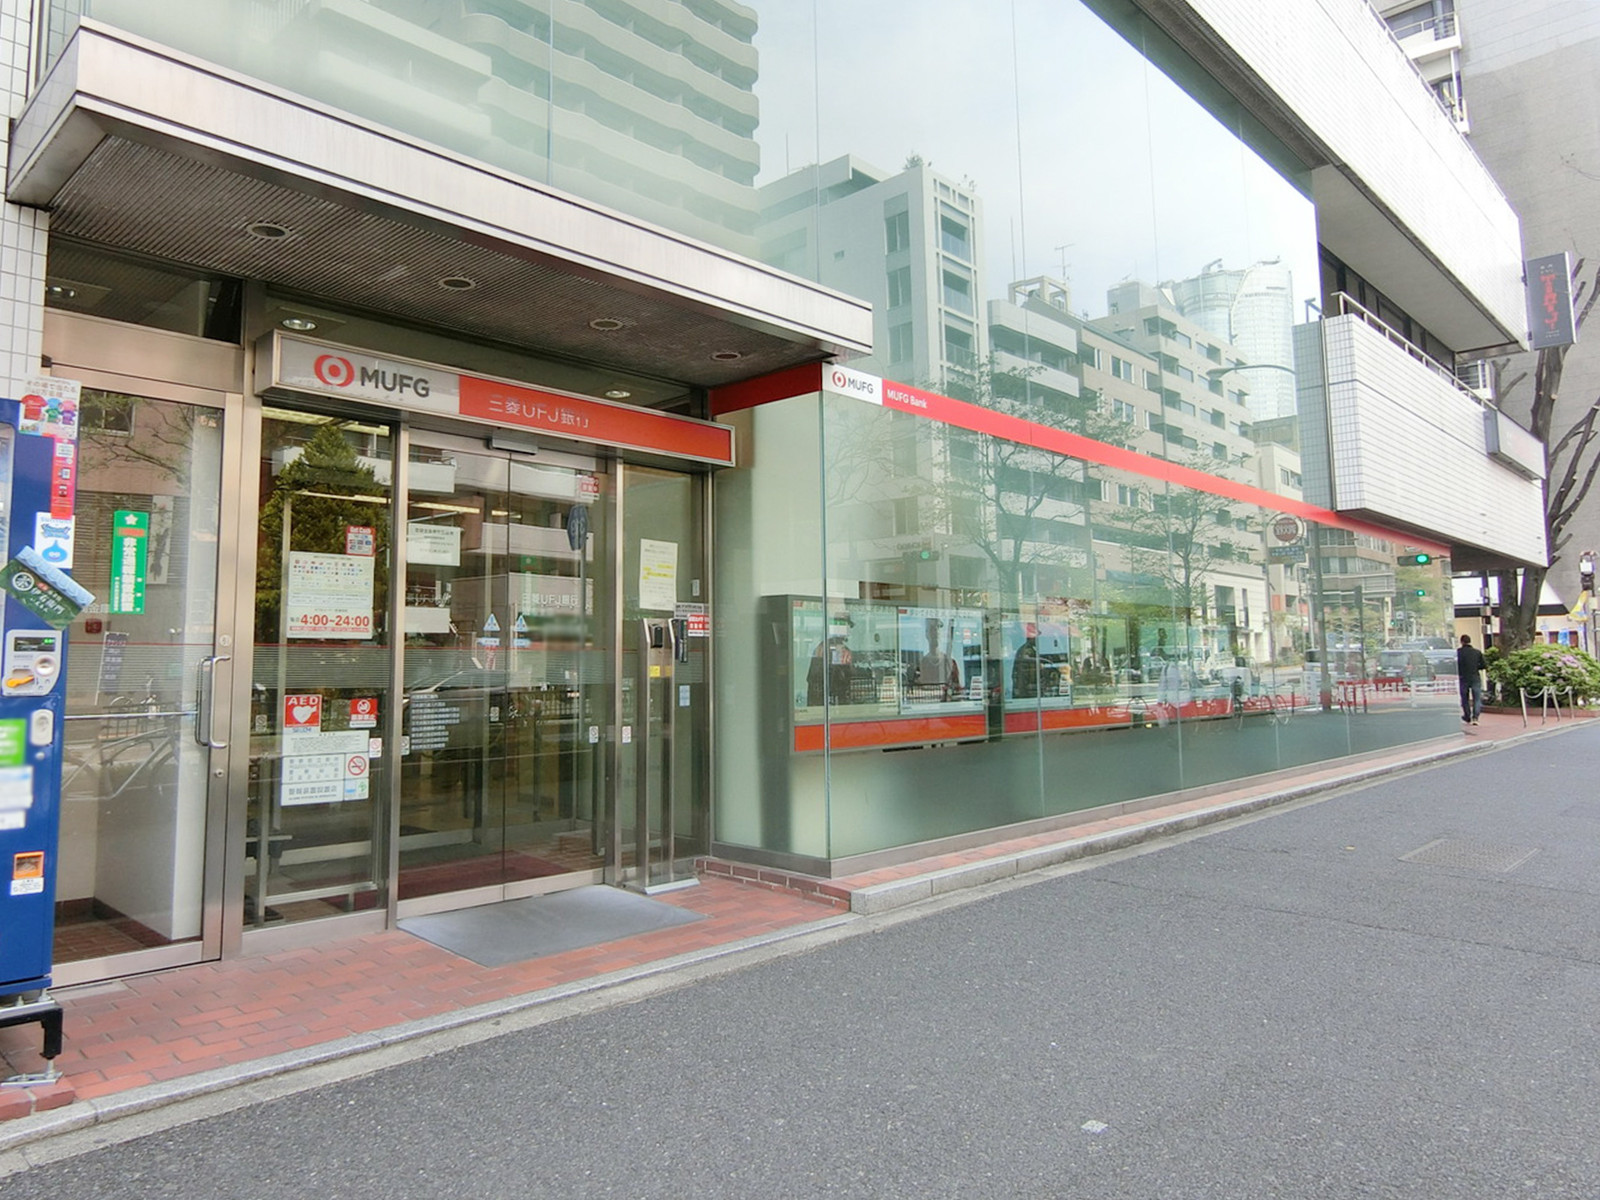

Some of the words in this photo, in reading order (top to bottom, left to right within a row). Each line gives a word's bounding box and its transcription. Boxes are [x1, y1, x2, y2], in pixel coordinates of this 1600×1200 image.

[360, 366, 430, 398] MUFG
[848, 378, 874, 394] MUFG
[887, 389, 909, 403] MUFG
[910, 395, 928, 409] Bank
[288, 696, 318, 705] AED
